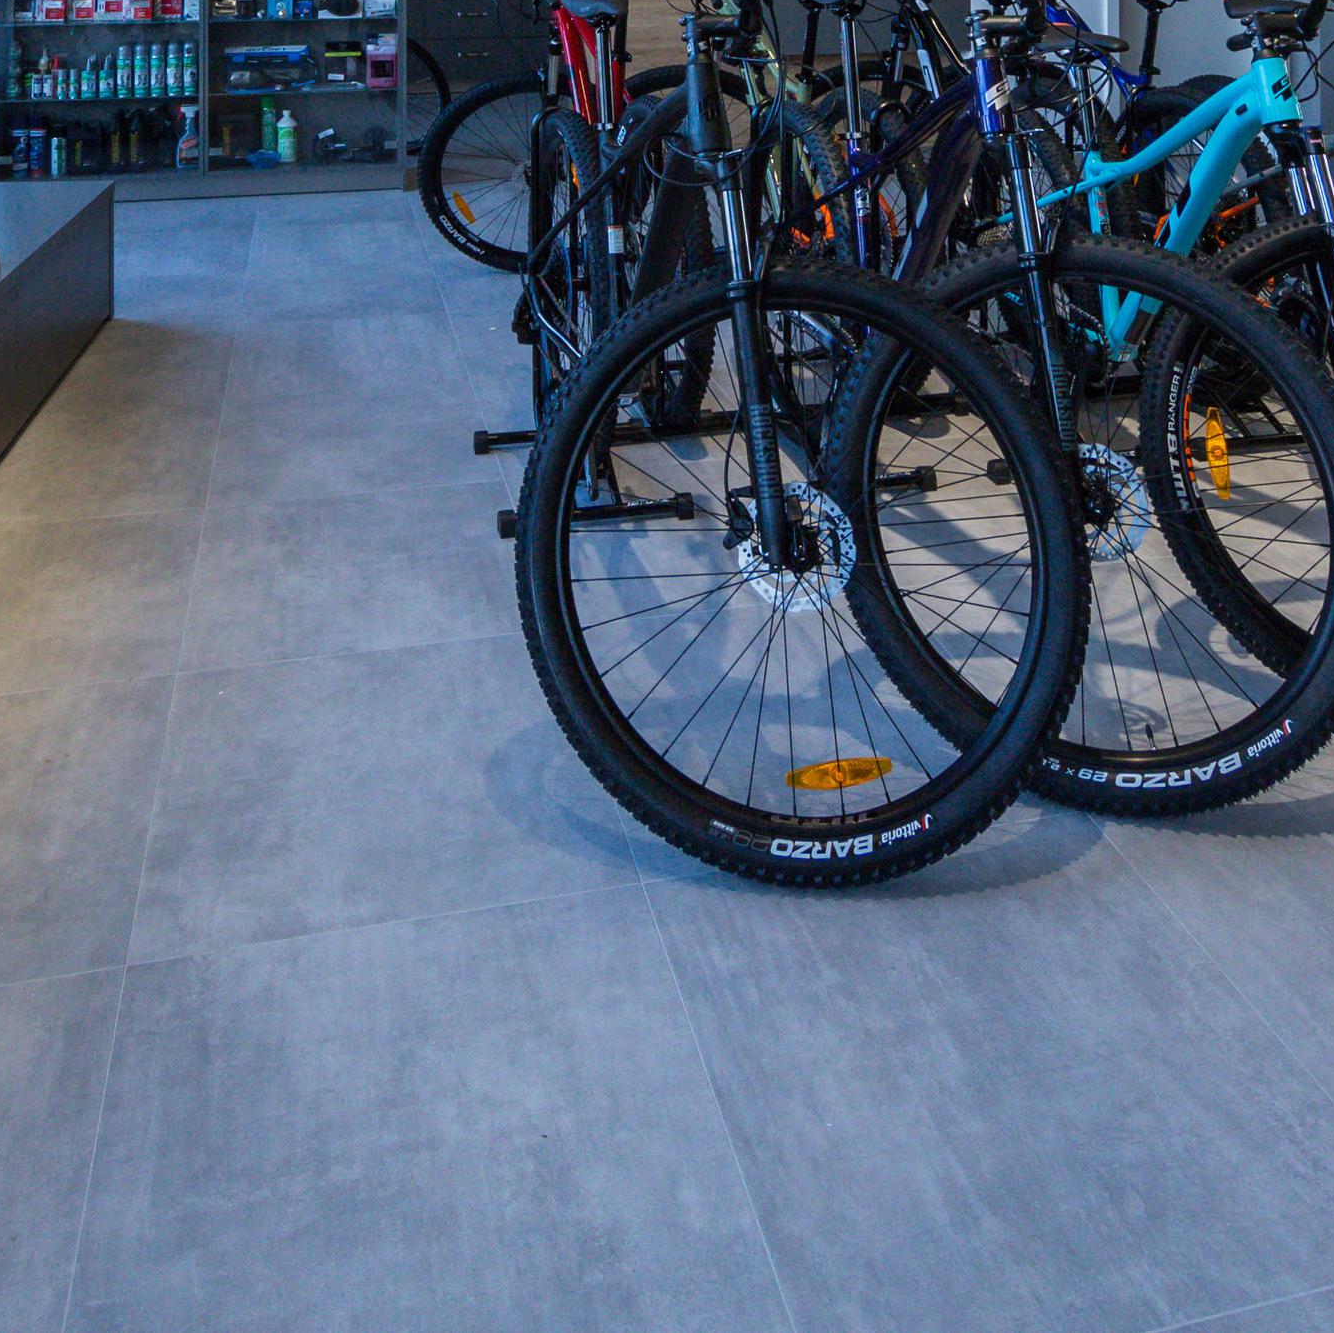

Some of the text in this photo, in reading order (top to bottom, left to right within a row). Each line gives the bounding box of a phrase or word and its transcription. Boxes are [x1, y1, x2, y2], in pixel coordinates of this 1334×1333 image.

[1168, 375, 1181, 431] RANGER
[750, 405, 781, 498] ROCKSHOX
[1247, 727, 1285, 758] vittoria
[1077, 767, 1110, 783] 29
[1115, 750, 1242, 789] BARZO
[770, 833, 875, 860] BARZO
[880, 819, 924, 846] vittoria
